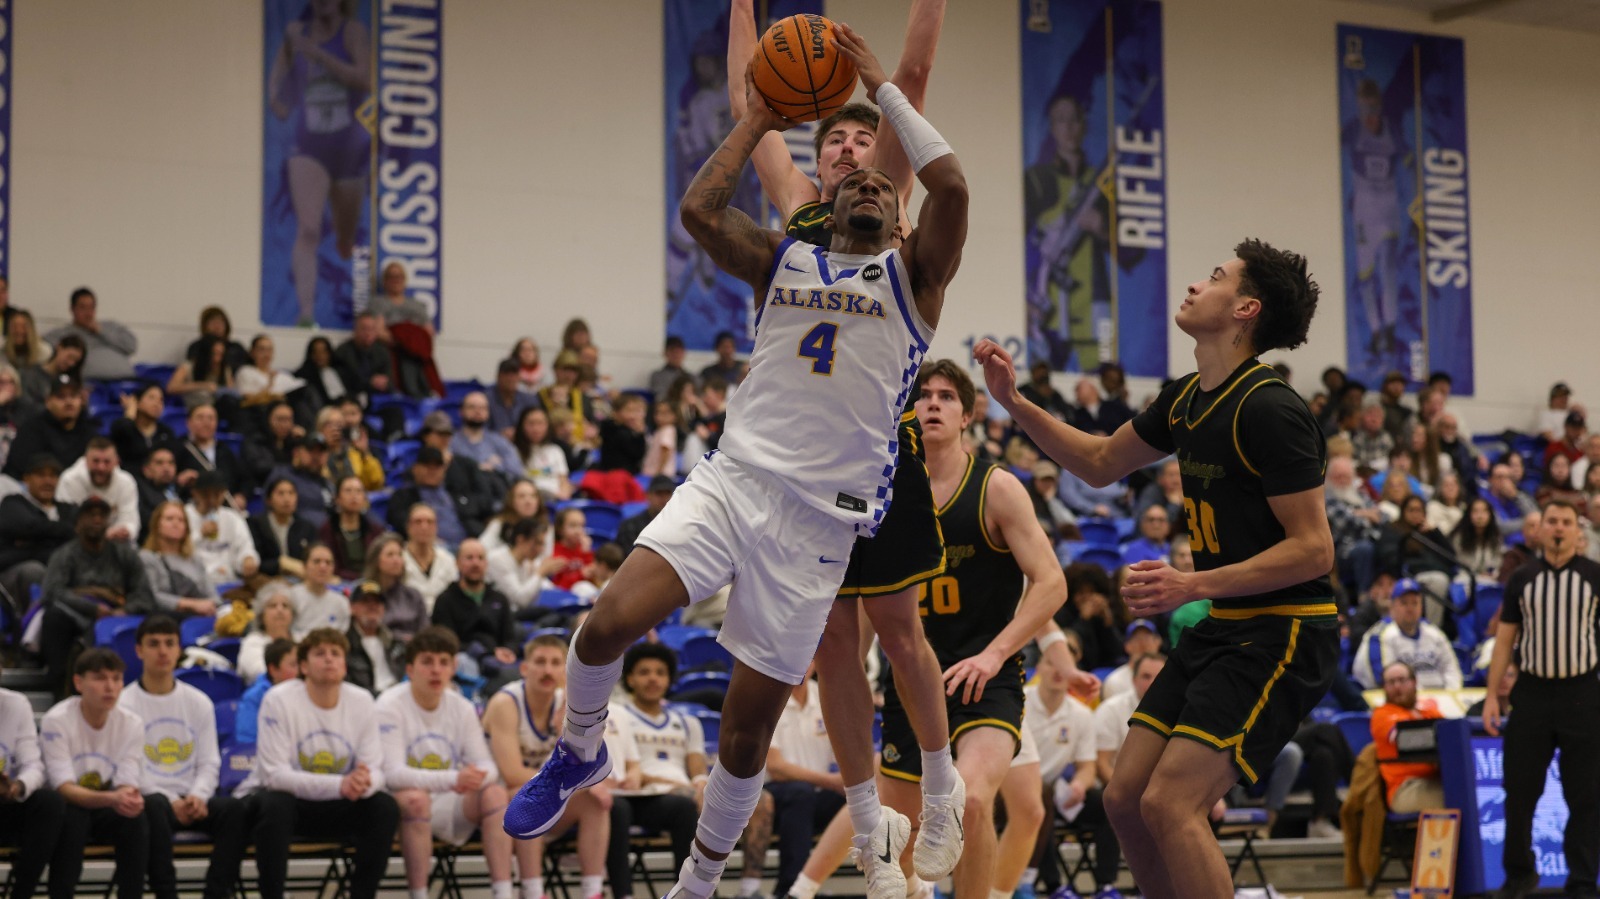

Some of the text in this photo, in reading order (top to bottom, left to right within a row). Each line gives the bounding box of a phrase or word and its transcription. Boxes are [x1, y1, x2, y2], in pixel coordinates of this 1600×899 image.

[1115, 126, 1164, 249] RIFLE
[1424, 147, 1469, 290] SKIING
[864, 268, 881, 278] WIN
[769, 285, 887, 320] ALASKA
[797, 320, 841, 377] 4
[962, 335, 1023, 371] 12
[1184, 497, 1220, 554] 30
